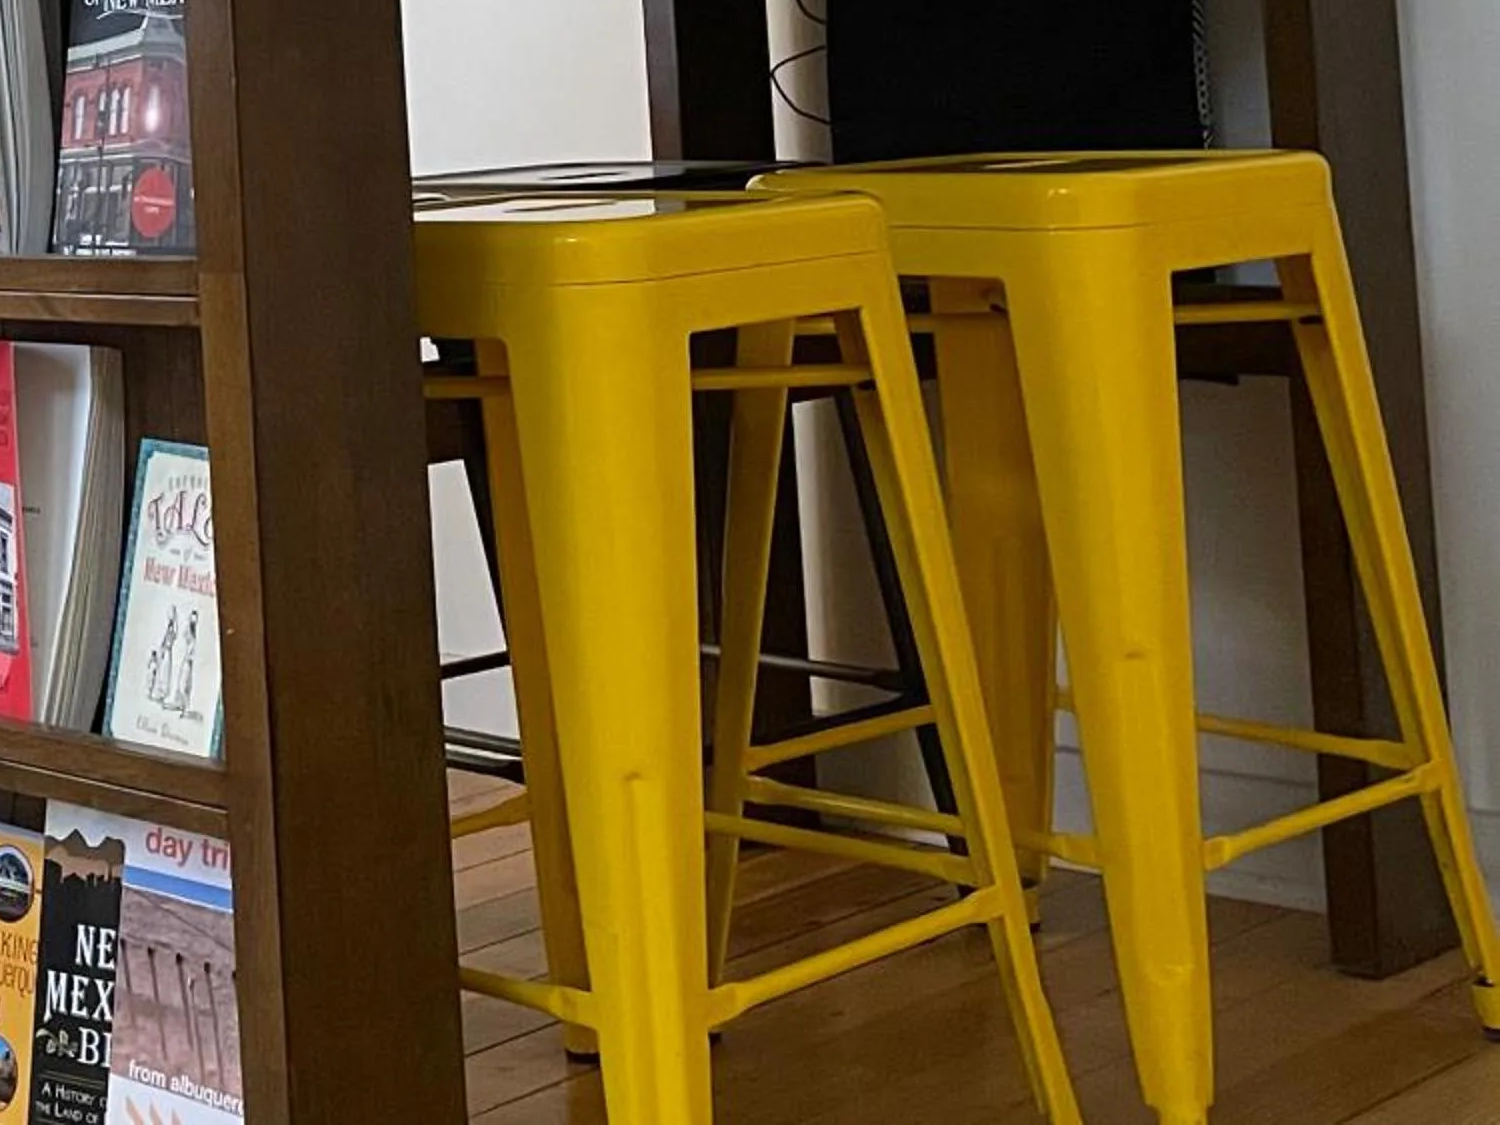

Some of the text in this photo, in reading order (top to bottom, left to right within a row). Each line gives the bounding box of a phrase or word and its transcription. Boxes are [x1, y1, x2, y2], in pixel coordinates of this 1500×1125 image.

[145, 826, 229, 871] day tri
[75, 924, 116, 970] NE
[43, 969, 115, 1024] MEX
[41, 1081, 52, 1098] A
[128, 1059, 167, 1088] from
